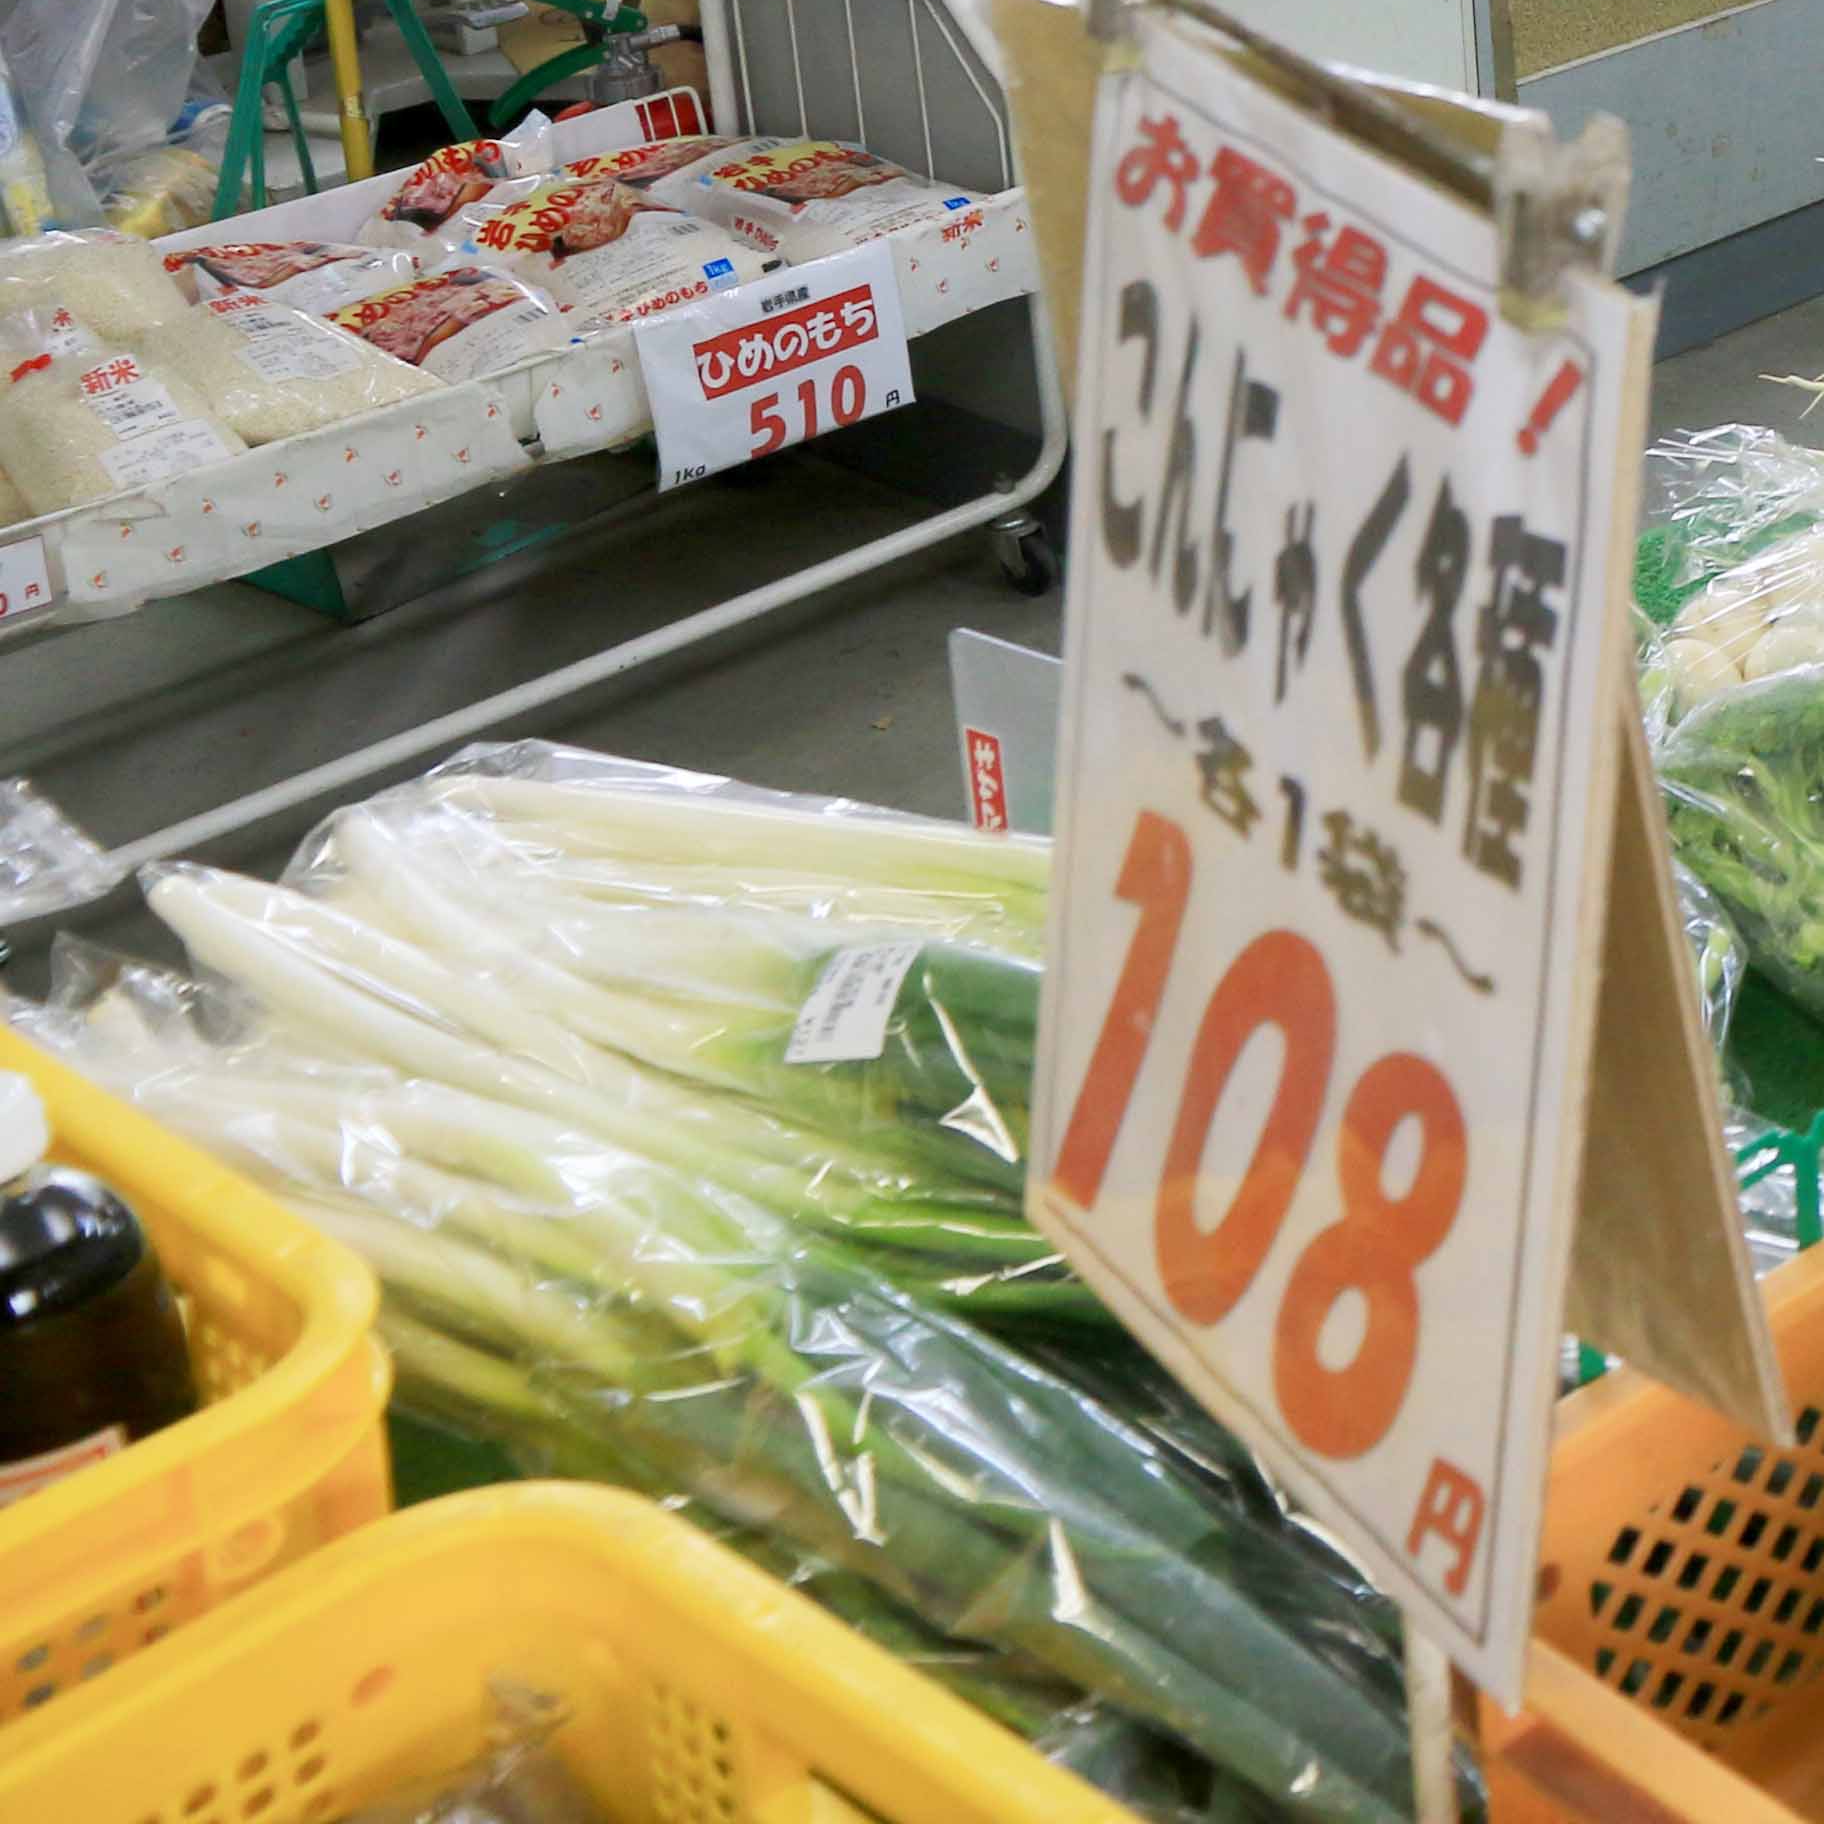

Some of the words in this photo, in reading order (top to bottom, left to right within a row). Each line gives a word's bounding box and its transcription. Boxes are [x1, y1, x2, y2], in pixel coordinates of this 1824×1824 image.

[760, 283, 812, 314] 岩手県産
[79, 357, 142, 395] 新米
[696, 298, 877, 391] ひめのもち
[1101, 276, 1567, 893] こんにゃく各種
